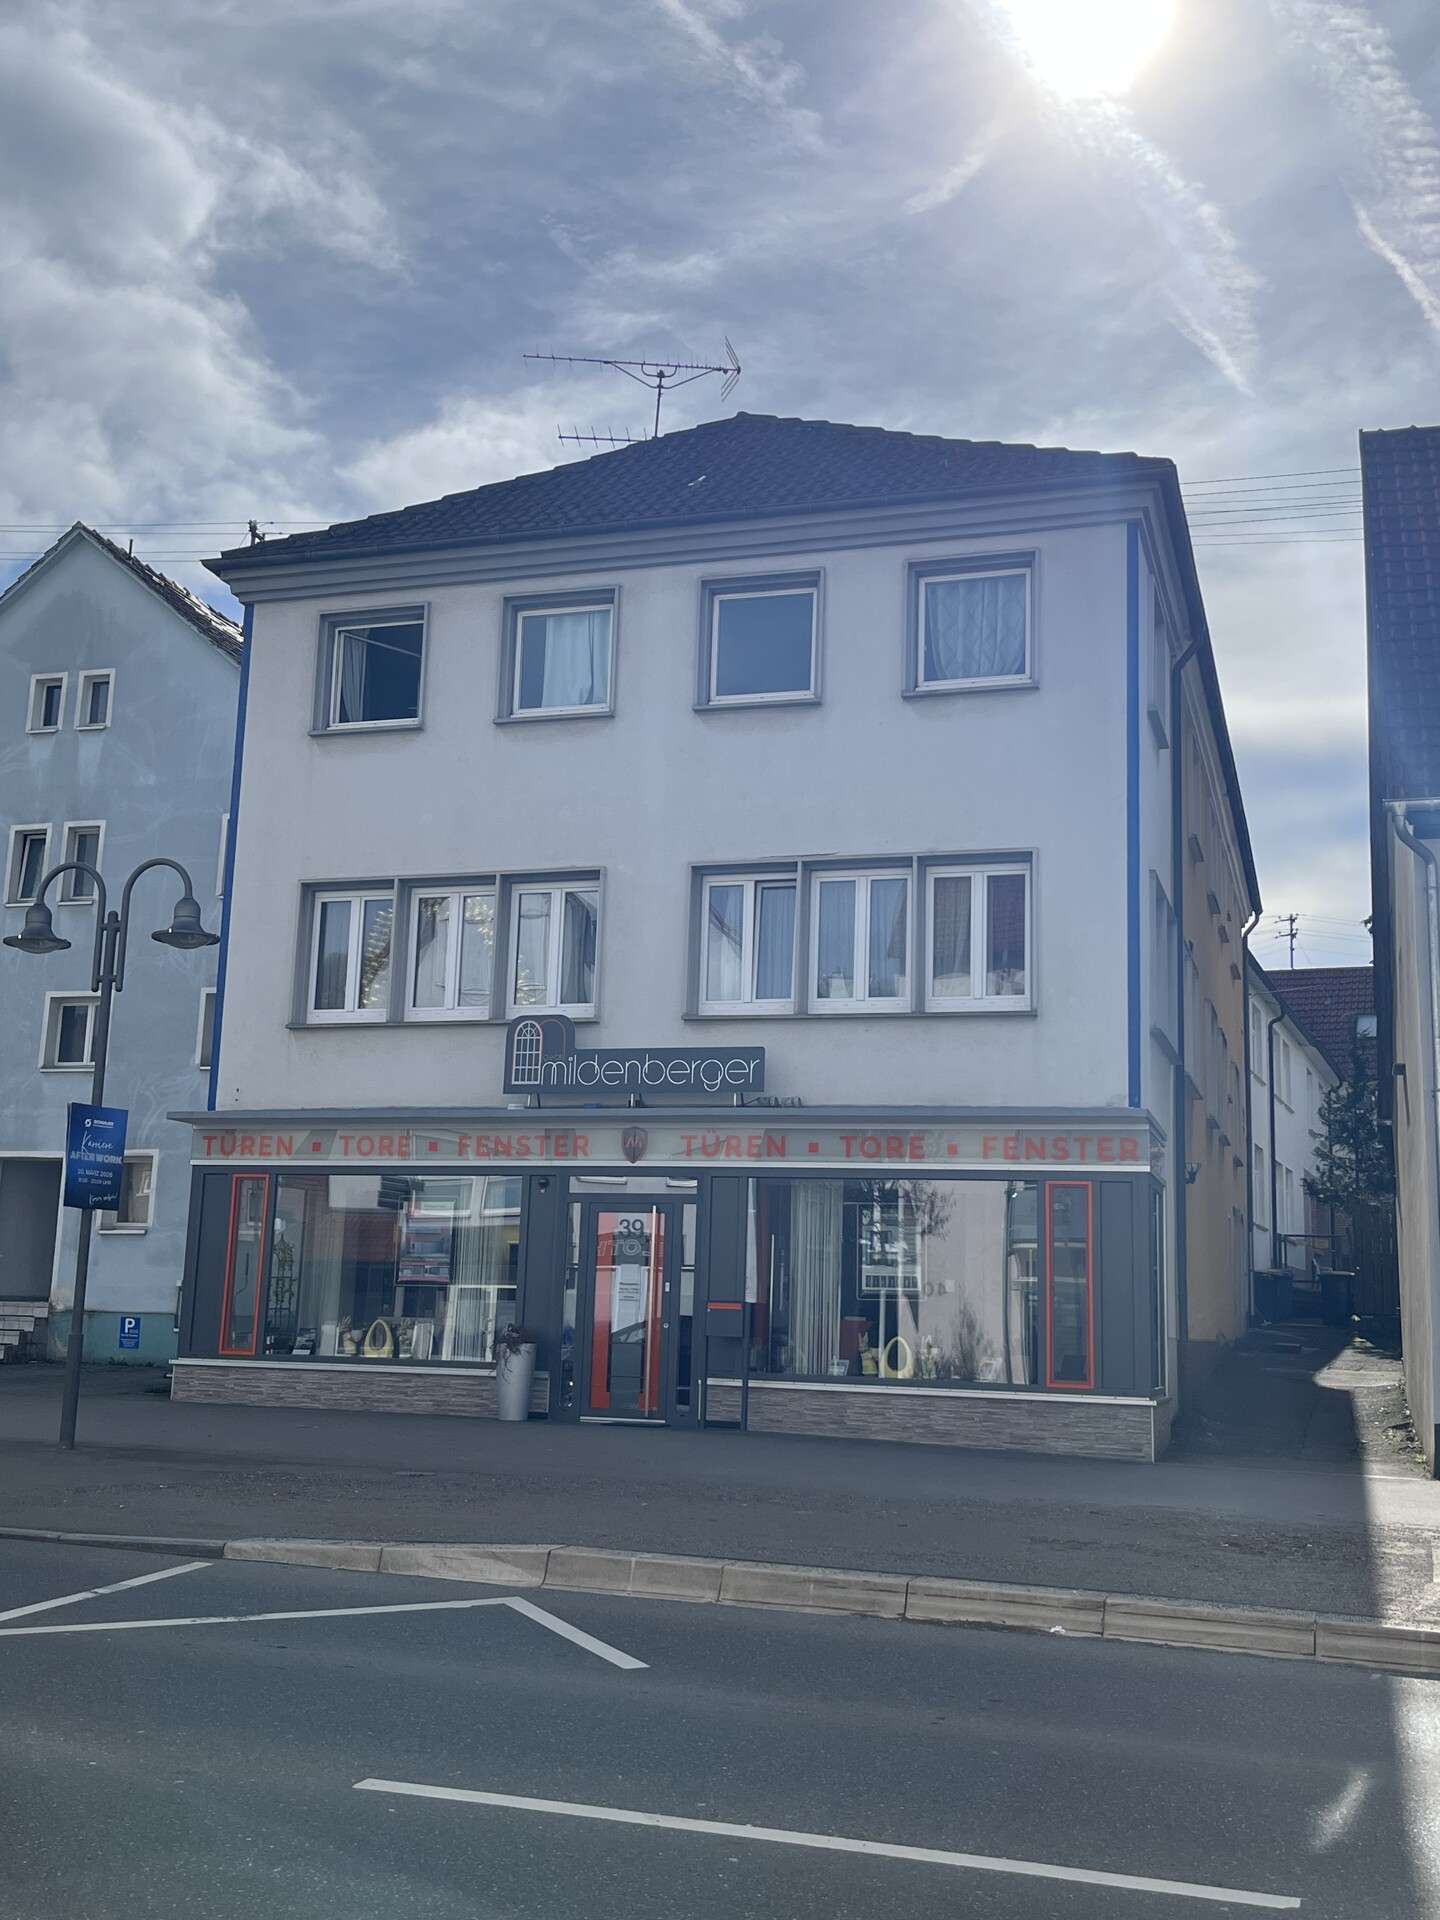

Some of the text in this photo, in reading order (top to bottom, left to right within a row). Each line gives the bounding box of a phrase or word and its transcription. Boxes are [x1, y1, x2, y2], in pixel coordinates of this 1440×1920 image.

[541, 1053, 761, 1092] mildenberger
[81, 1129, 113, 1154] Karriere
[203, 1129, 591, 1158] TÜREN TORE FENSTER
[681, 1129, 1139, 1162] TÜREN TORE FENSTER
[70, 1151, 122, 1164] AFTER WORK
[620, 1219, 644, 1239] 39
[125, 1318, 136, 1334] P
